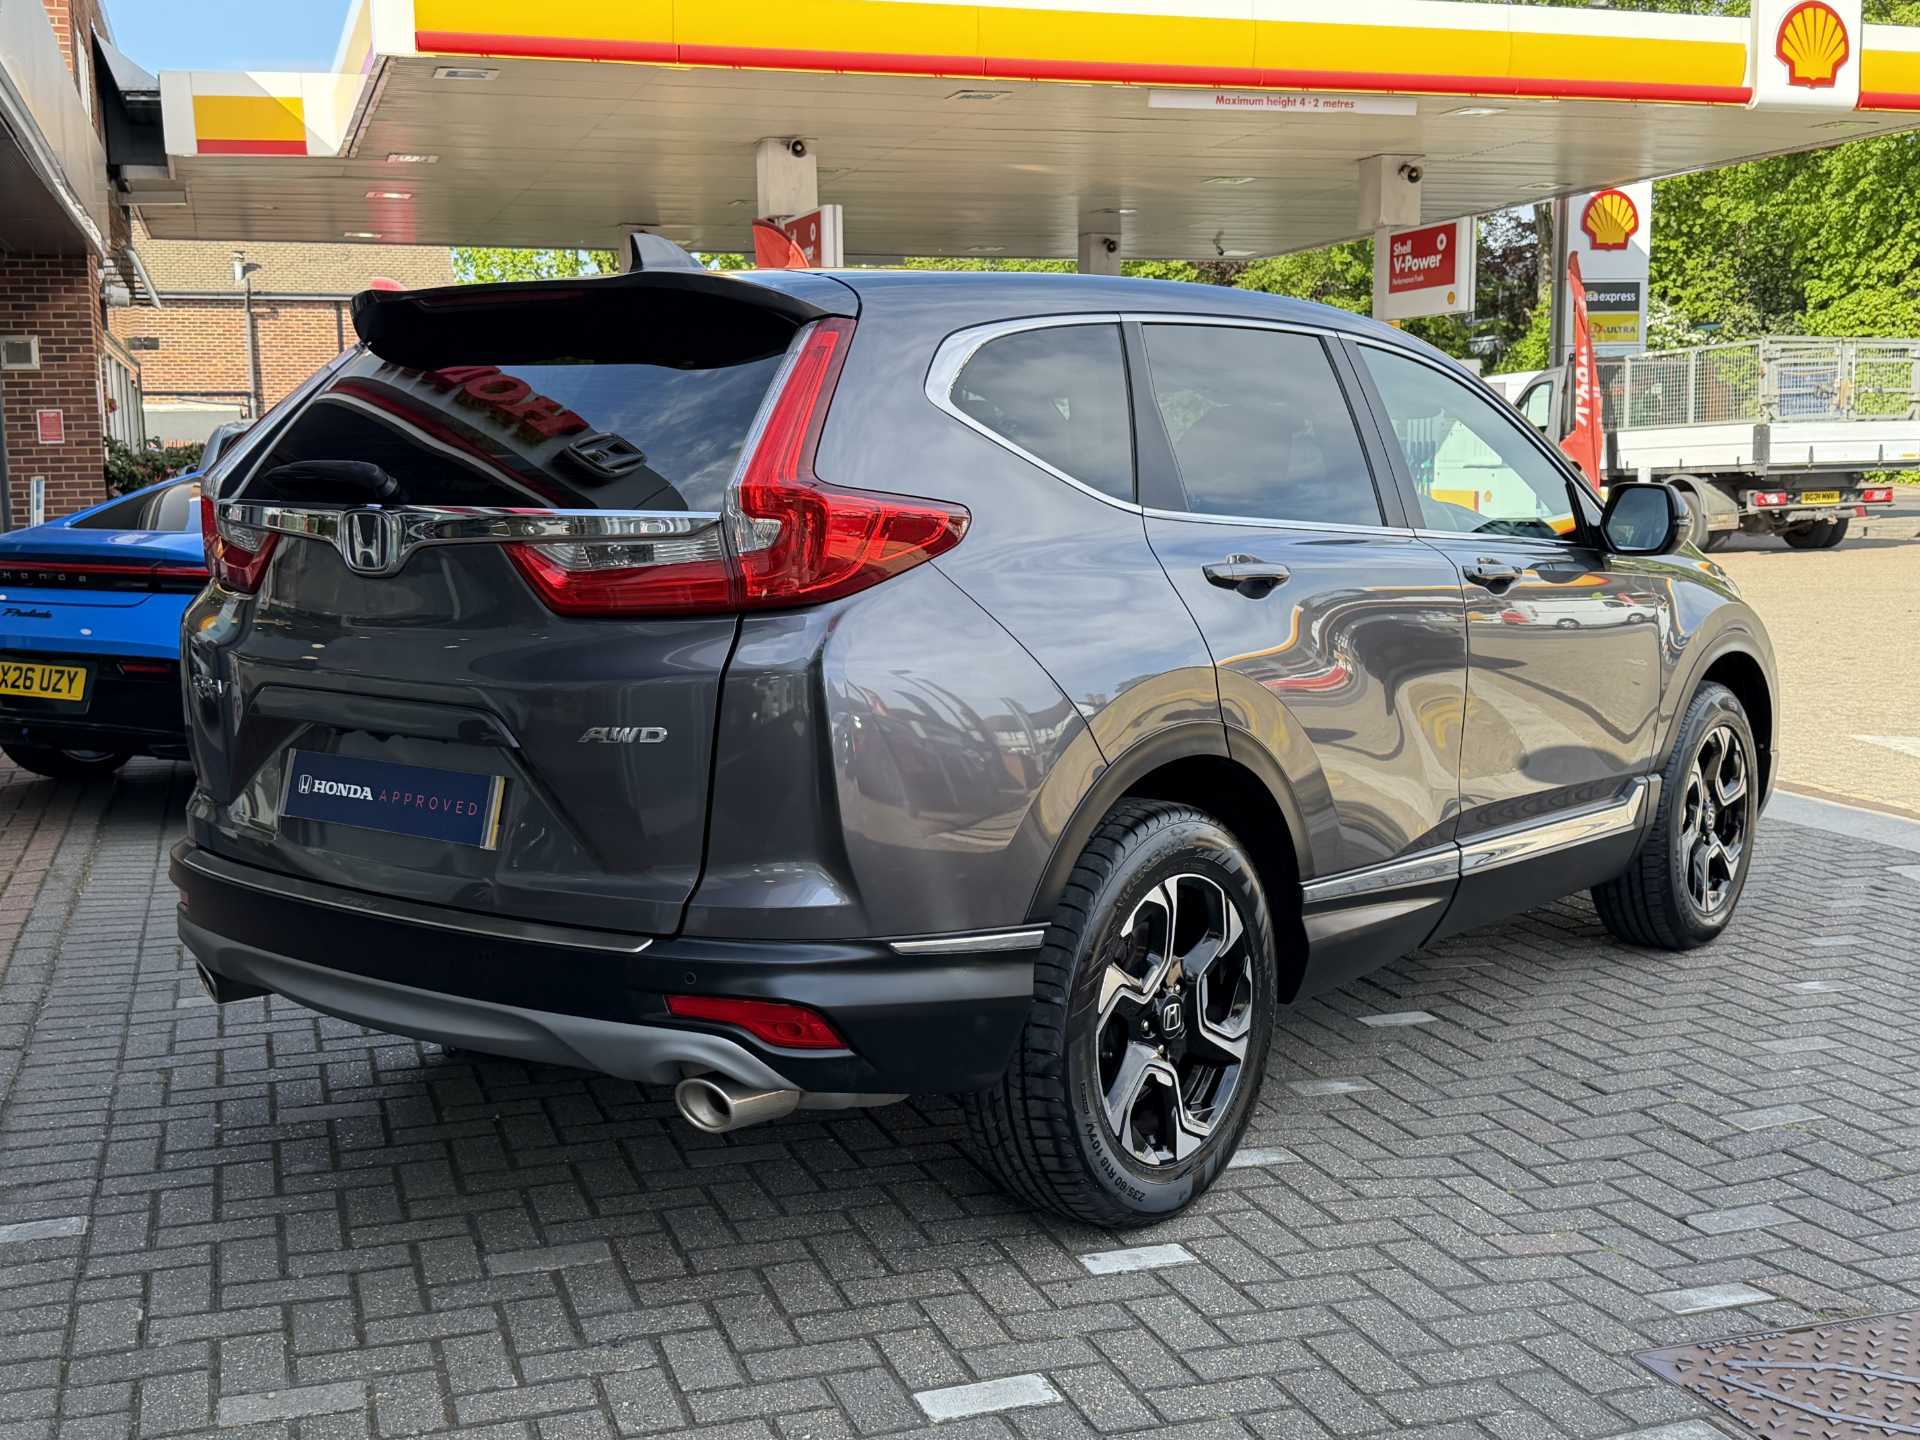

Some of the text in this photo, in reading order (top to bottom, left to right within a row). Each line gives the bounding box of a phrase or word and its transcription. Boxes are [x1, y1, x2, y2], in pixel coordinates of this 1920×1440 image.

[1215, 95, 1264, 106] Maximum
[1266, 97, 1296, 109] height
[1322, 99, 1354, 109] metres
[1393, 240, 1412, 256] Shell
[1393, 253, 1442, 274] V-Power
[1600, 292, 1636, 304] express
[1606, 325, 1636, 334] ULTRA
[40, 667, 79, 694] UZY
[577, 726, 668, 743] AWD
[312, 779, 478, 816] HONDA APPROVED
